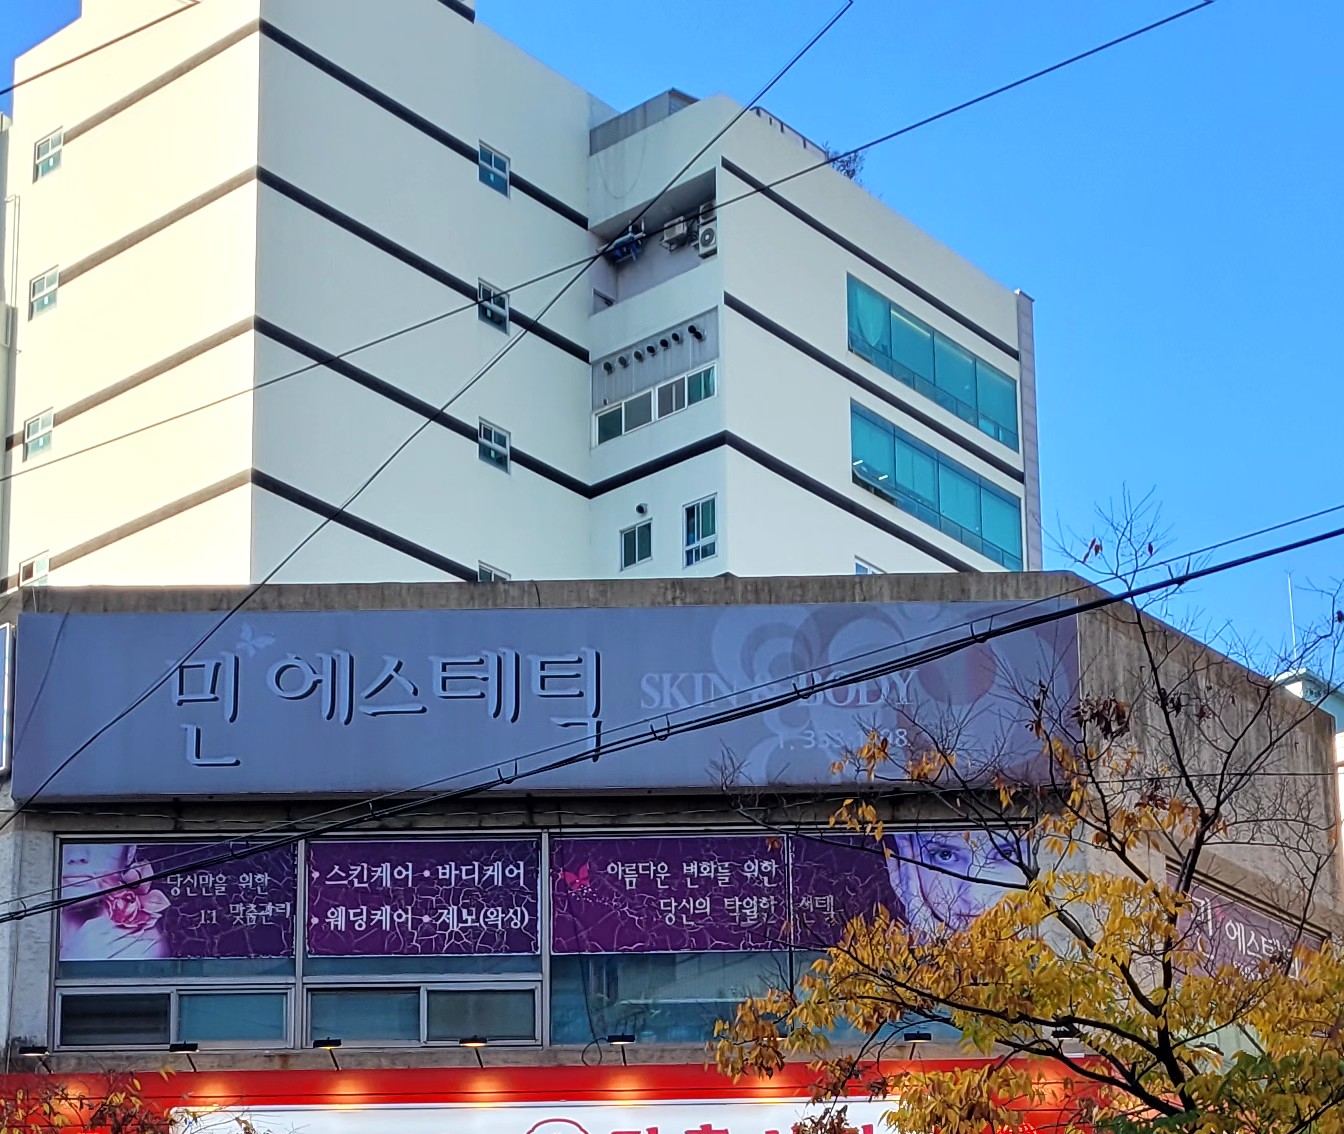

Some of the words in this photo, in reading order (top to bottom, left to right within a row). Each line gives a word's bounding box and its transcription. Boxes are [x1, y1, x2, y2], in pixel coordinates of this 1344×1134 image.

[640, 672, 733, 710] SKIN
[796, 668, 919, 708] BODY
[167, 872, 228, 897] 당신만을
[238, 872, 271, 897] 위한
[325, 861, 414, 889] 스킨케어
[435, 860, 526, 888] 바디케어
[606, 860, 672, 891] 아름다운
[683, 859, 732, 890] 변화를
[743, 858, 779, 890] 위한
[229, 901, 291, 927] 맞춤관리
[325, 904, 413, 932] 웨딩케어
[435, 904, 530, 932] 제모(왁싱)
[659, 896, 712, 927] 당신의
